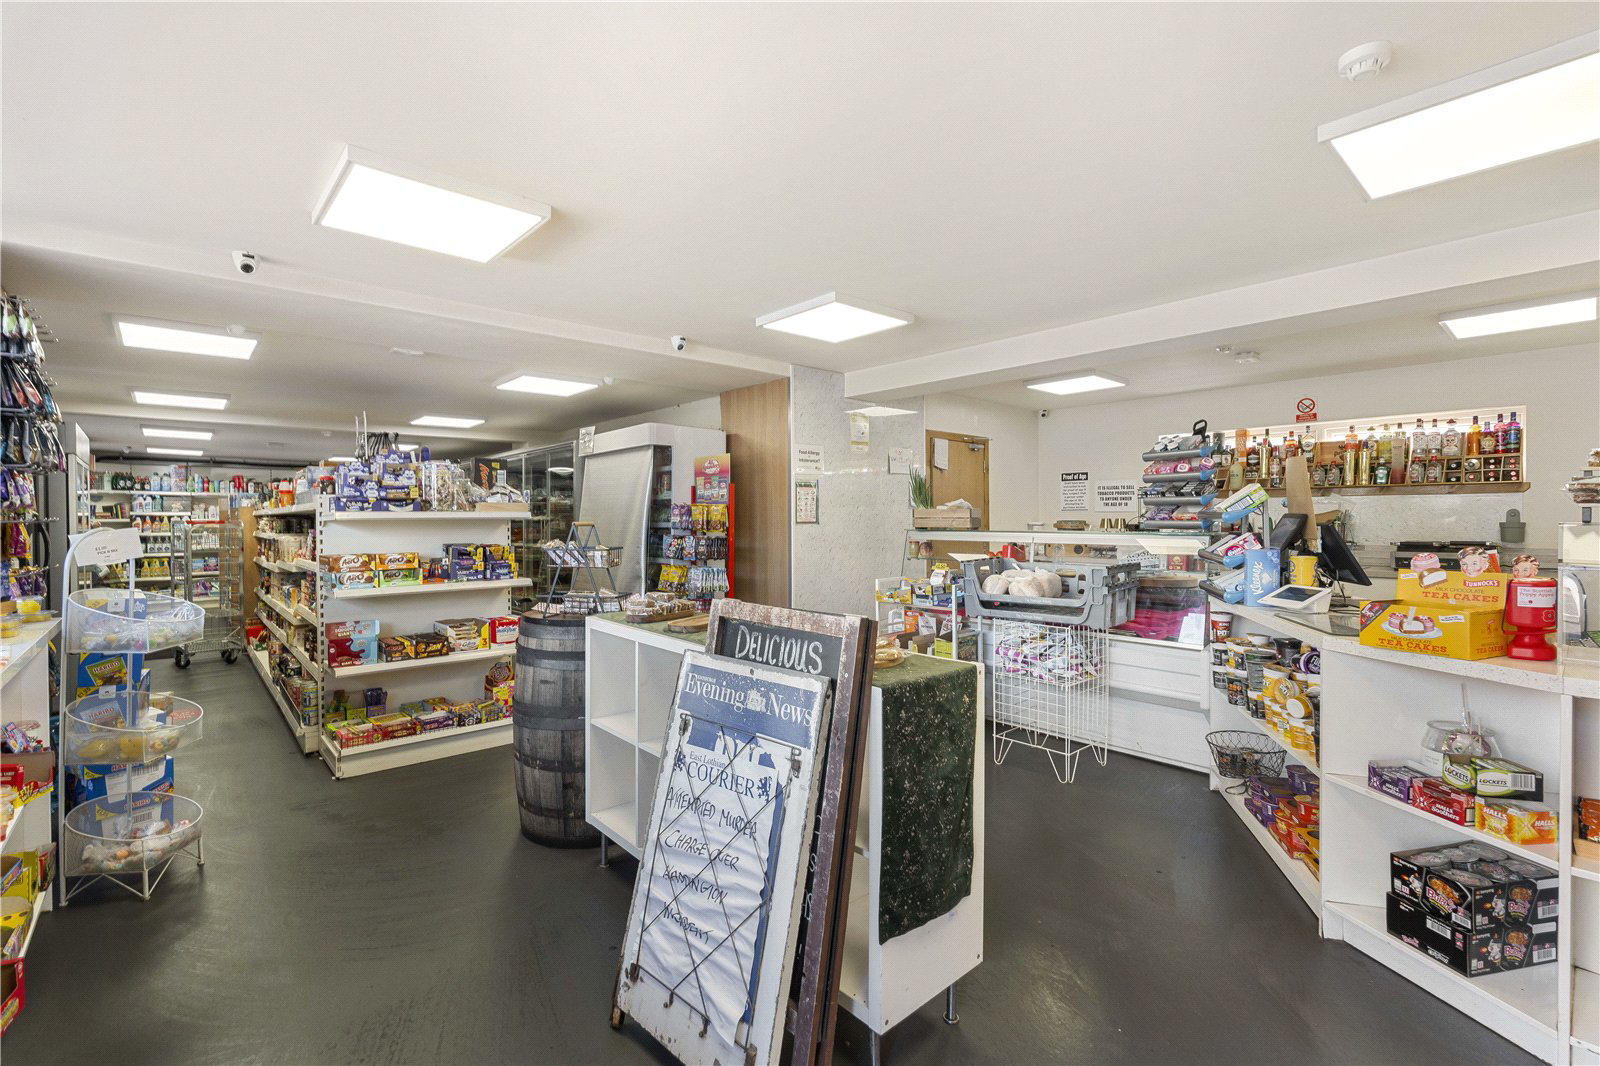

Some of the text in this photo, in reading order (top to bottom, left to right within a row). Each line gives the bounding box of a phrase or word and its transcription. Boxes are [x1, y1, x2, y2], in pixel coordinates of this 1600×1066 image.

[1079, 473, 1087, 481] Age
[1250, 560, 1264, 595] Kleenex
[1422, 591, 1500, 603] TEA CAKES
[735, 625, 823, 675] DELICIOUS
[1378, 637, 1402, 647] TEA
[1406, 641, 1448, 653] CAKES
[93, 660, 122, 673] HARIBO
[685, 672, 814, 727] Evening News
[690, 751, 727, 768] East Lothian
[687, 761, 755, 799] COURIER
[1444, 765, 1469, 783] LOCKETS
[1479, 779, 1508, 787] LOCKETS
[1382, 785, 1404, 799] Soothers
[1431, 806, 1460, 822] Soothers
[1435, 803, 1453, 814] HALLS
[1483, 807, 1508, 820] HALLS
[719, 809, 758, 839] MURDER
[664, 829, 740, 872] CHARGE OVER
